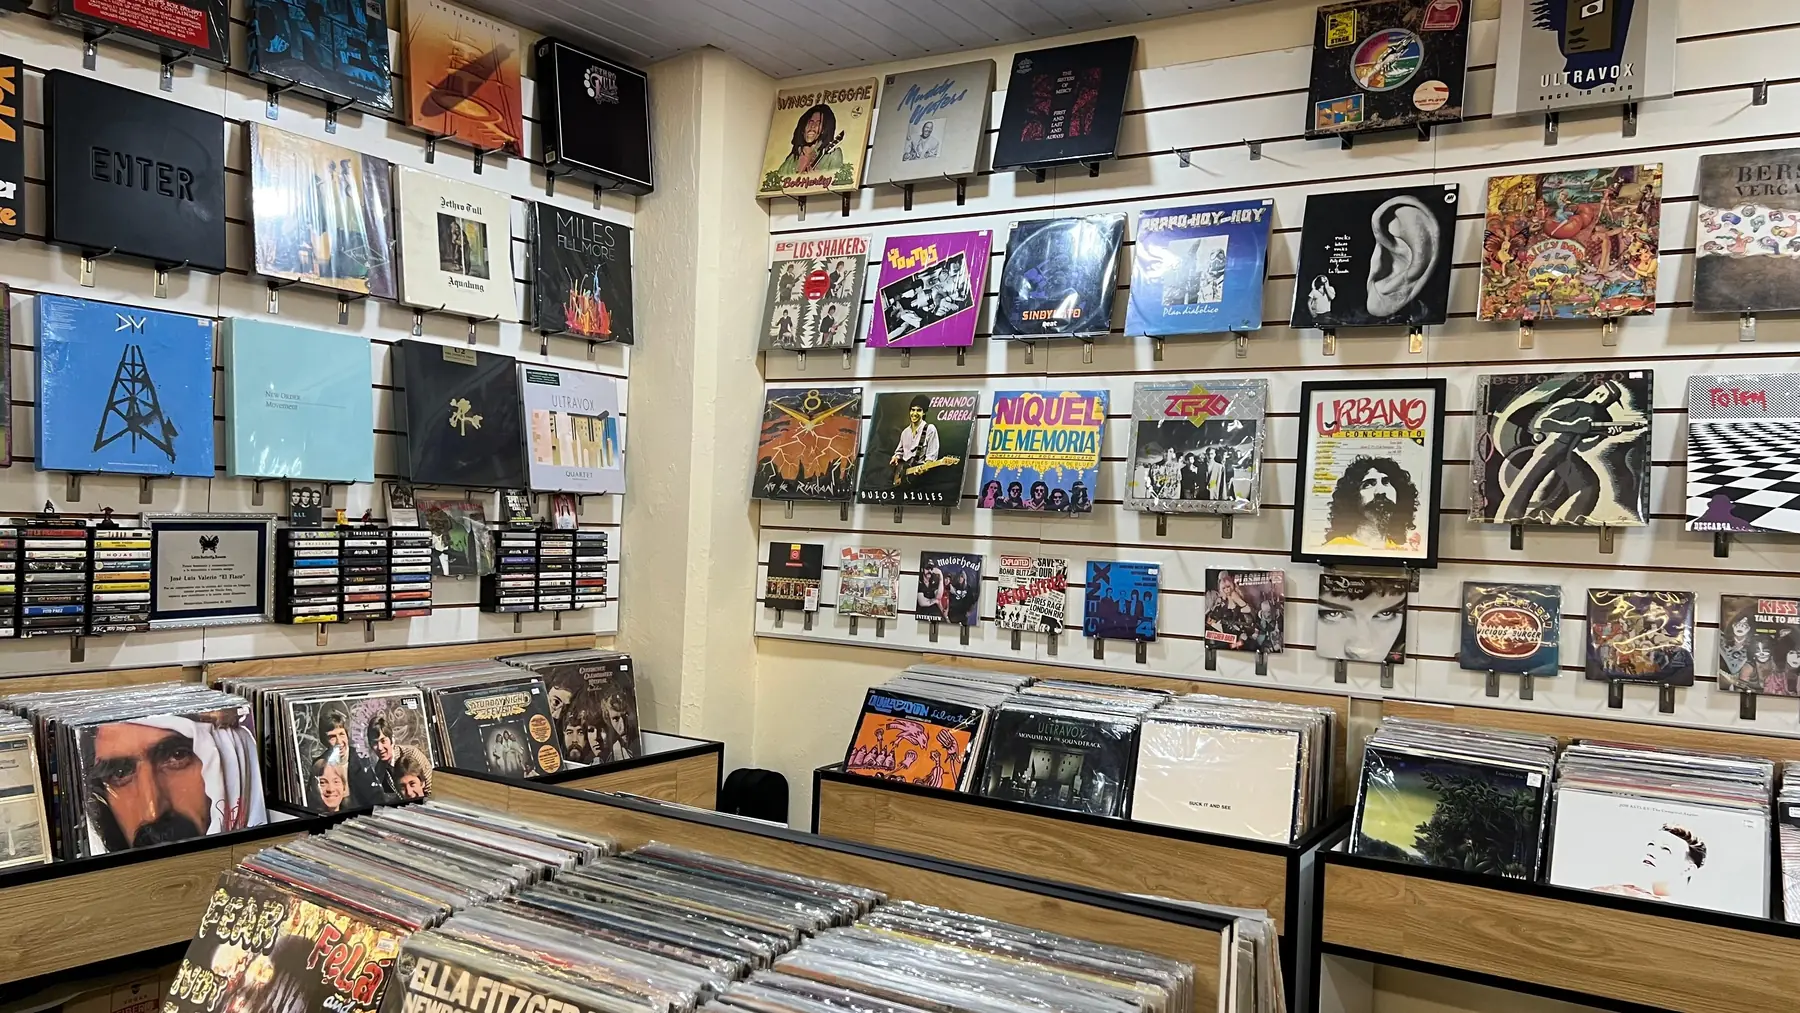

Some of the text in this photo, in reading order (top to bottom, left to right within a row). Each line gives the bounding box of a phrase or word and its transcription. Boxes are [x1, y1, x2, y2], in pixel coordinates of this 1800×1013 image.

[1540, 63, 1634, 88] ULTRAVOX
[91, 146, 195, 202] ENTER
[1736, 163, 1800, 184] BER
[440, 196, 484, 216] Jethro Tull
[557, 211, 616, 249] MILES
[793, 238, 869, 264] LOS SHAKERS
[448, 276, 486, 299] Aqualung
[1162, 306, 1180, 317] Plan
[551, 394, 595, 412] ULTRAVOX
[928, 395, 976, 413] FERNANDO
[996, 396, 1103, 427] NIQUEL
[936, 408, 973, 422] CABRERA
[1316, 397, 1427, 437] URBANO
[565, 470, 594, 480] QUARTET
[861, 491, 944, 502] BUZOS AZULES
[936, 558, 982, 572] Motörhead
[1037, 558, 1055, 568] SAVE
[1038, 567, 1053, 578] OUR
[1029, 604, 1053, 617] LONDON
[1757, 598, 1800, 616] KISS
[916, 614, 943, 622] INTERVIEW
[1754, 615, 1800, 626] TALK TO ME
[1477, 628, 1541, 639] VICIOUS BURGER
[1017, 732, 1052, 742] MONUMENT
[1061, 738, 1102, 749] SOUNDTRACK
[408, 956, 472, 1007] ELLA
